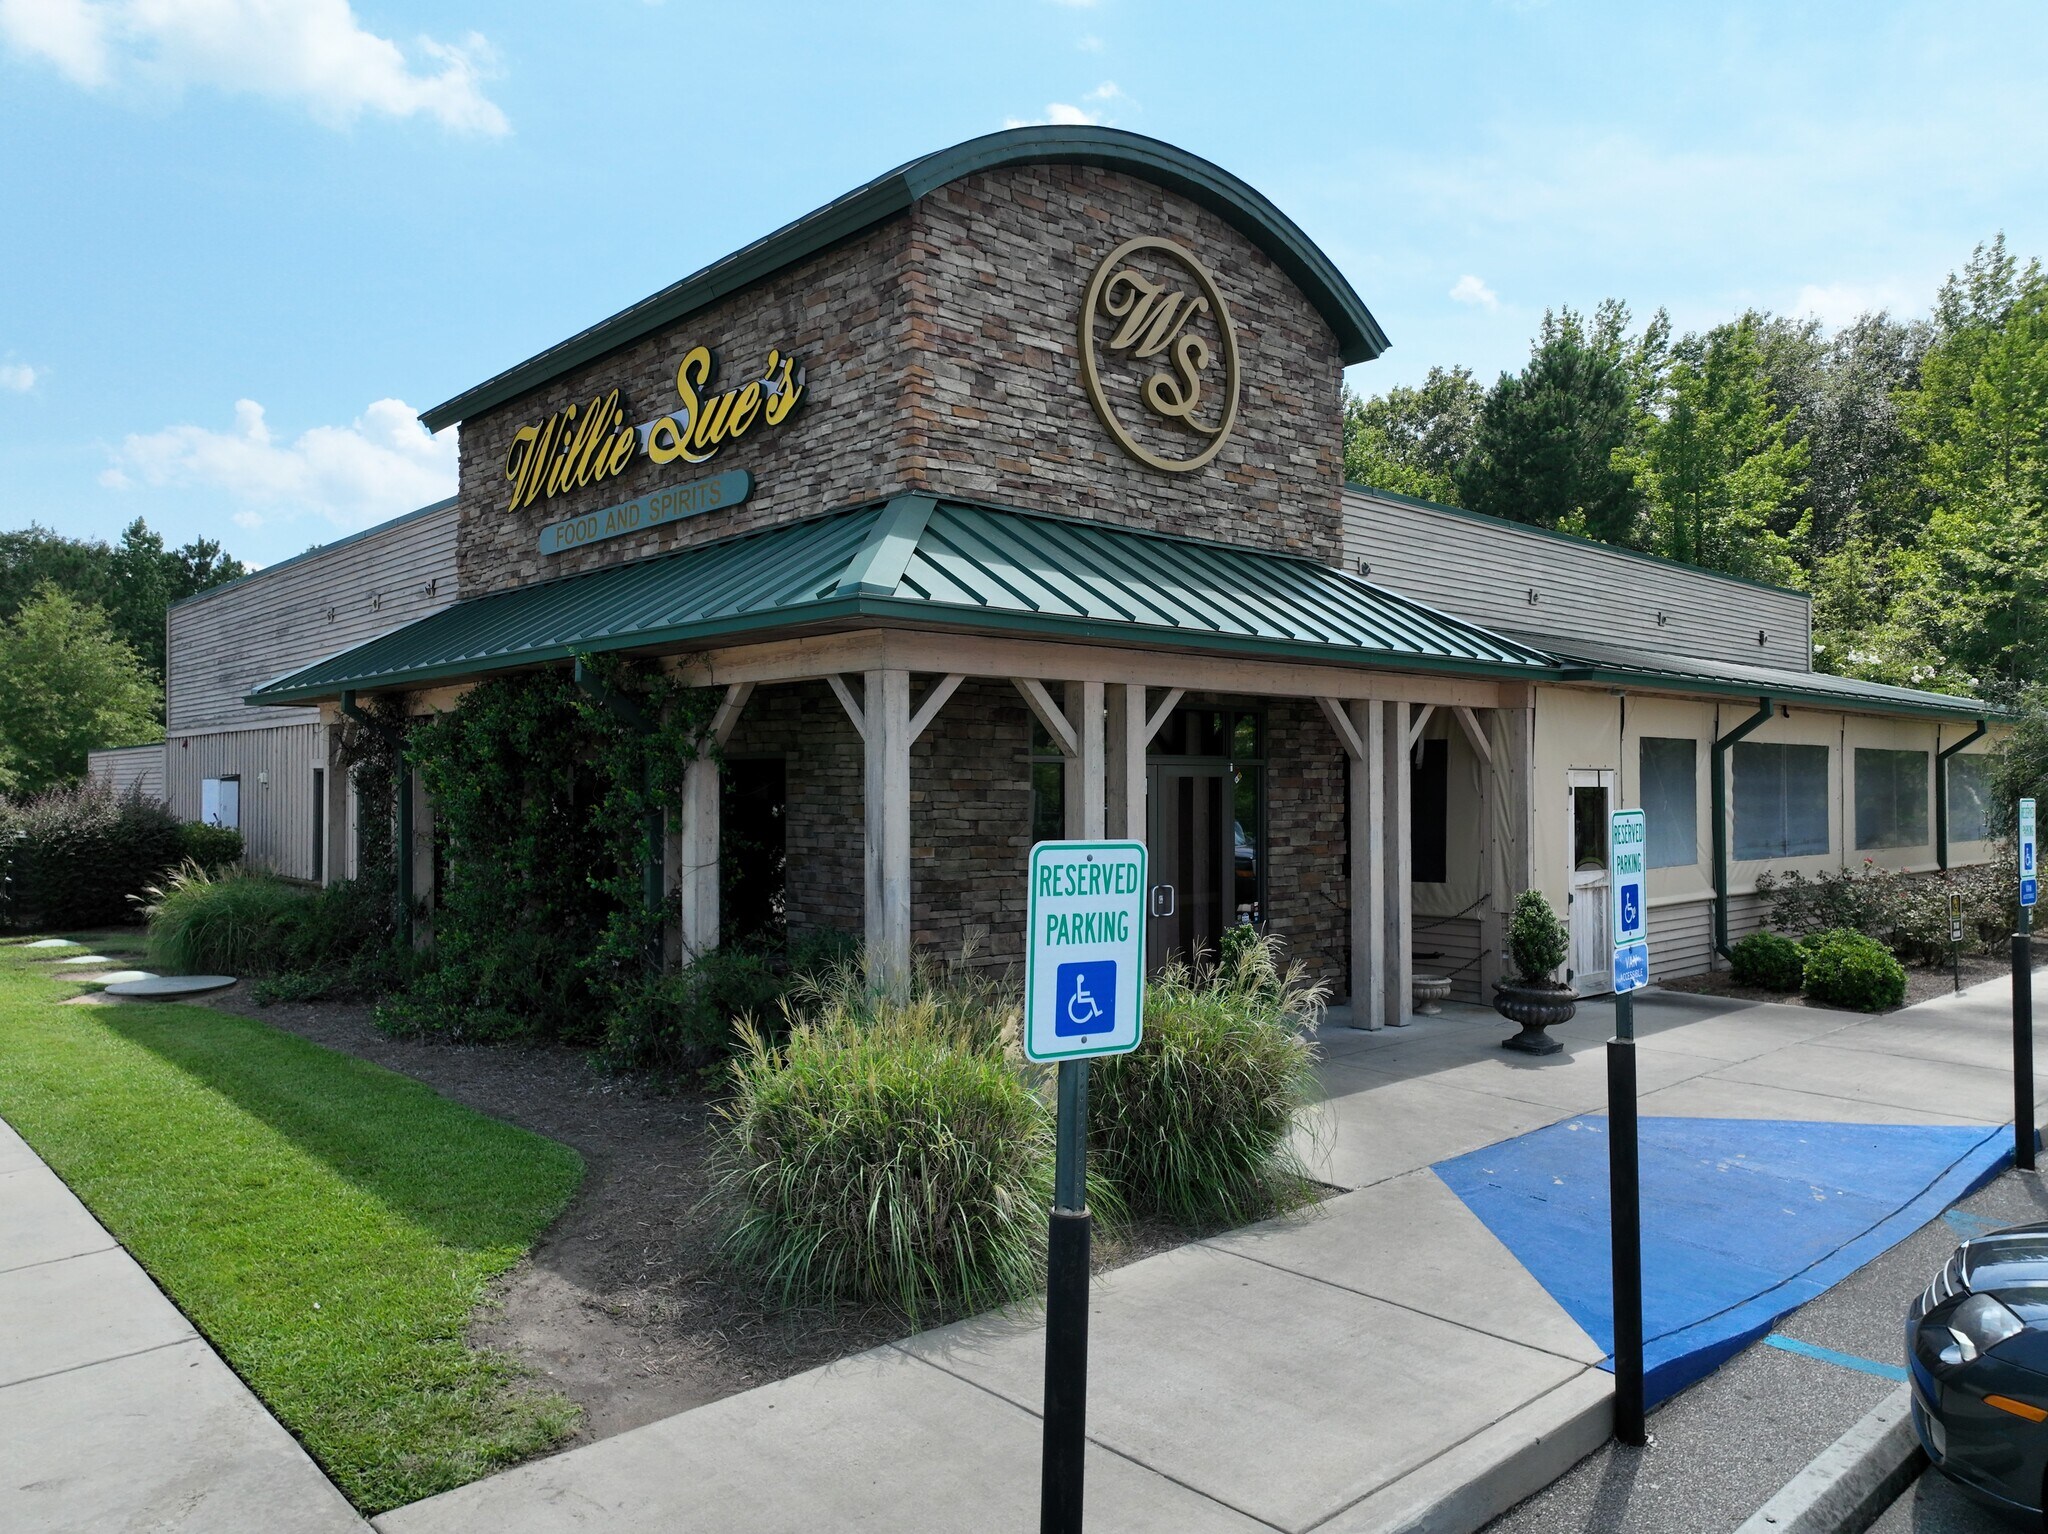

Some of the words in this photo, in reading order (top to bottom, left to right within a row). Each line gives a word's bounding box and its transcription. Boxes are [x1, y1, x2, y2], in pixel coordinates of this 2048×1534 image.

[505, 388, 636, 513] Willie
[648, 346, 803, 464] Sue's
[556, 517, 598, 548] FOOD
[604, 504, 640, 534] AND
[650, 480, 722, 522] SPIRITS
[1614, 823, 1643, 845] RESERVED
[1039, 863, 1138, 897] RESERVED
[1616, 853, 1641, 875] PARKING
[1046, 911, 1129, 946] PARKING
